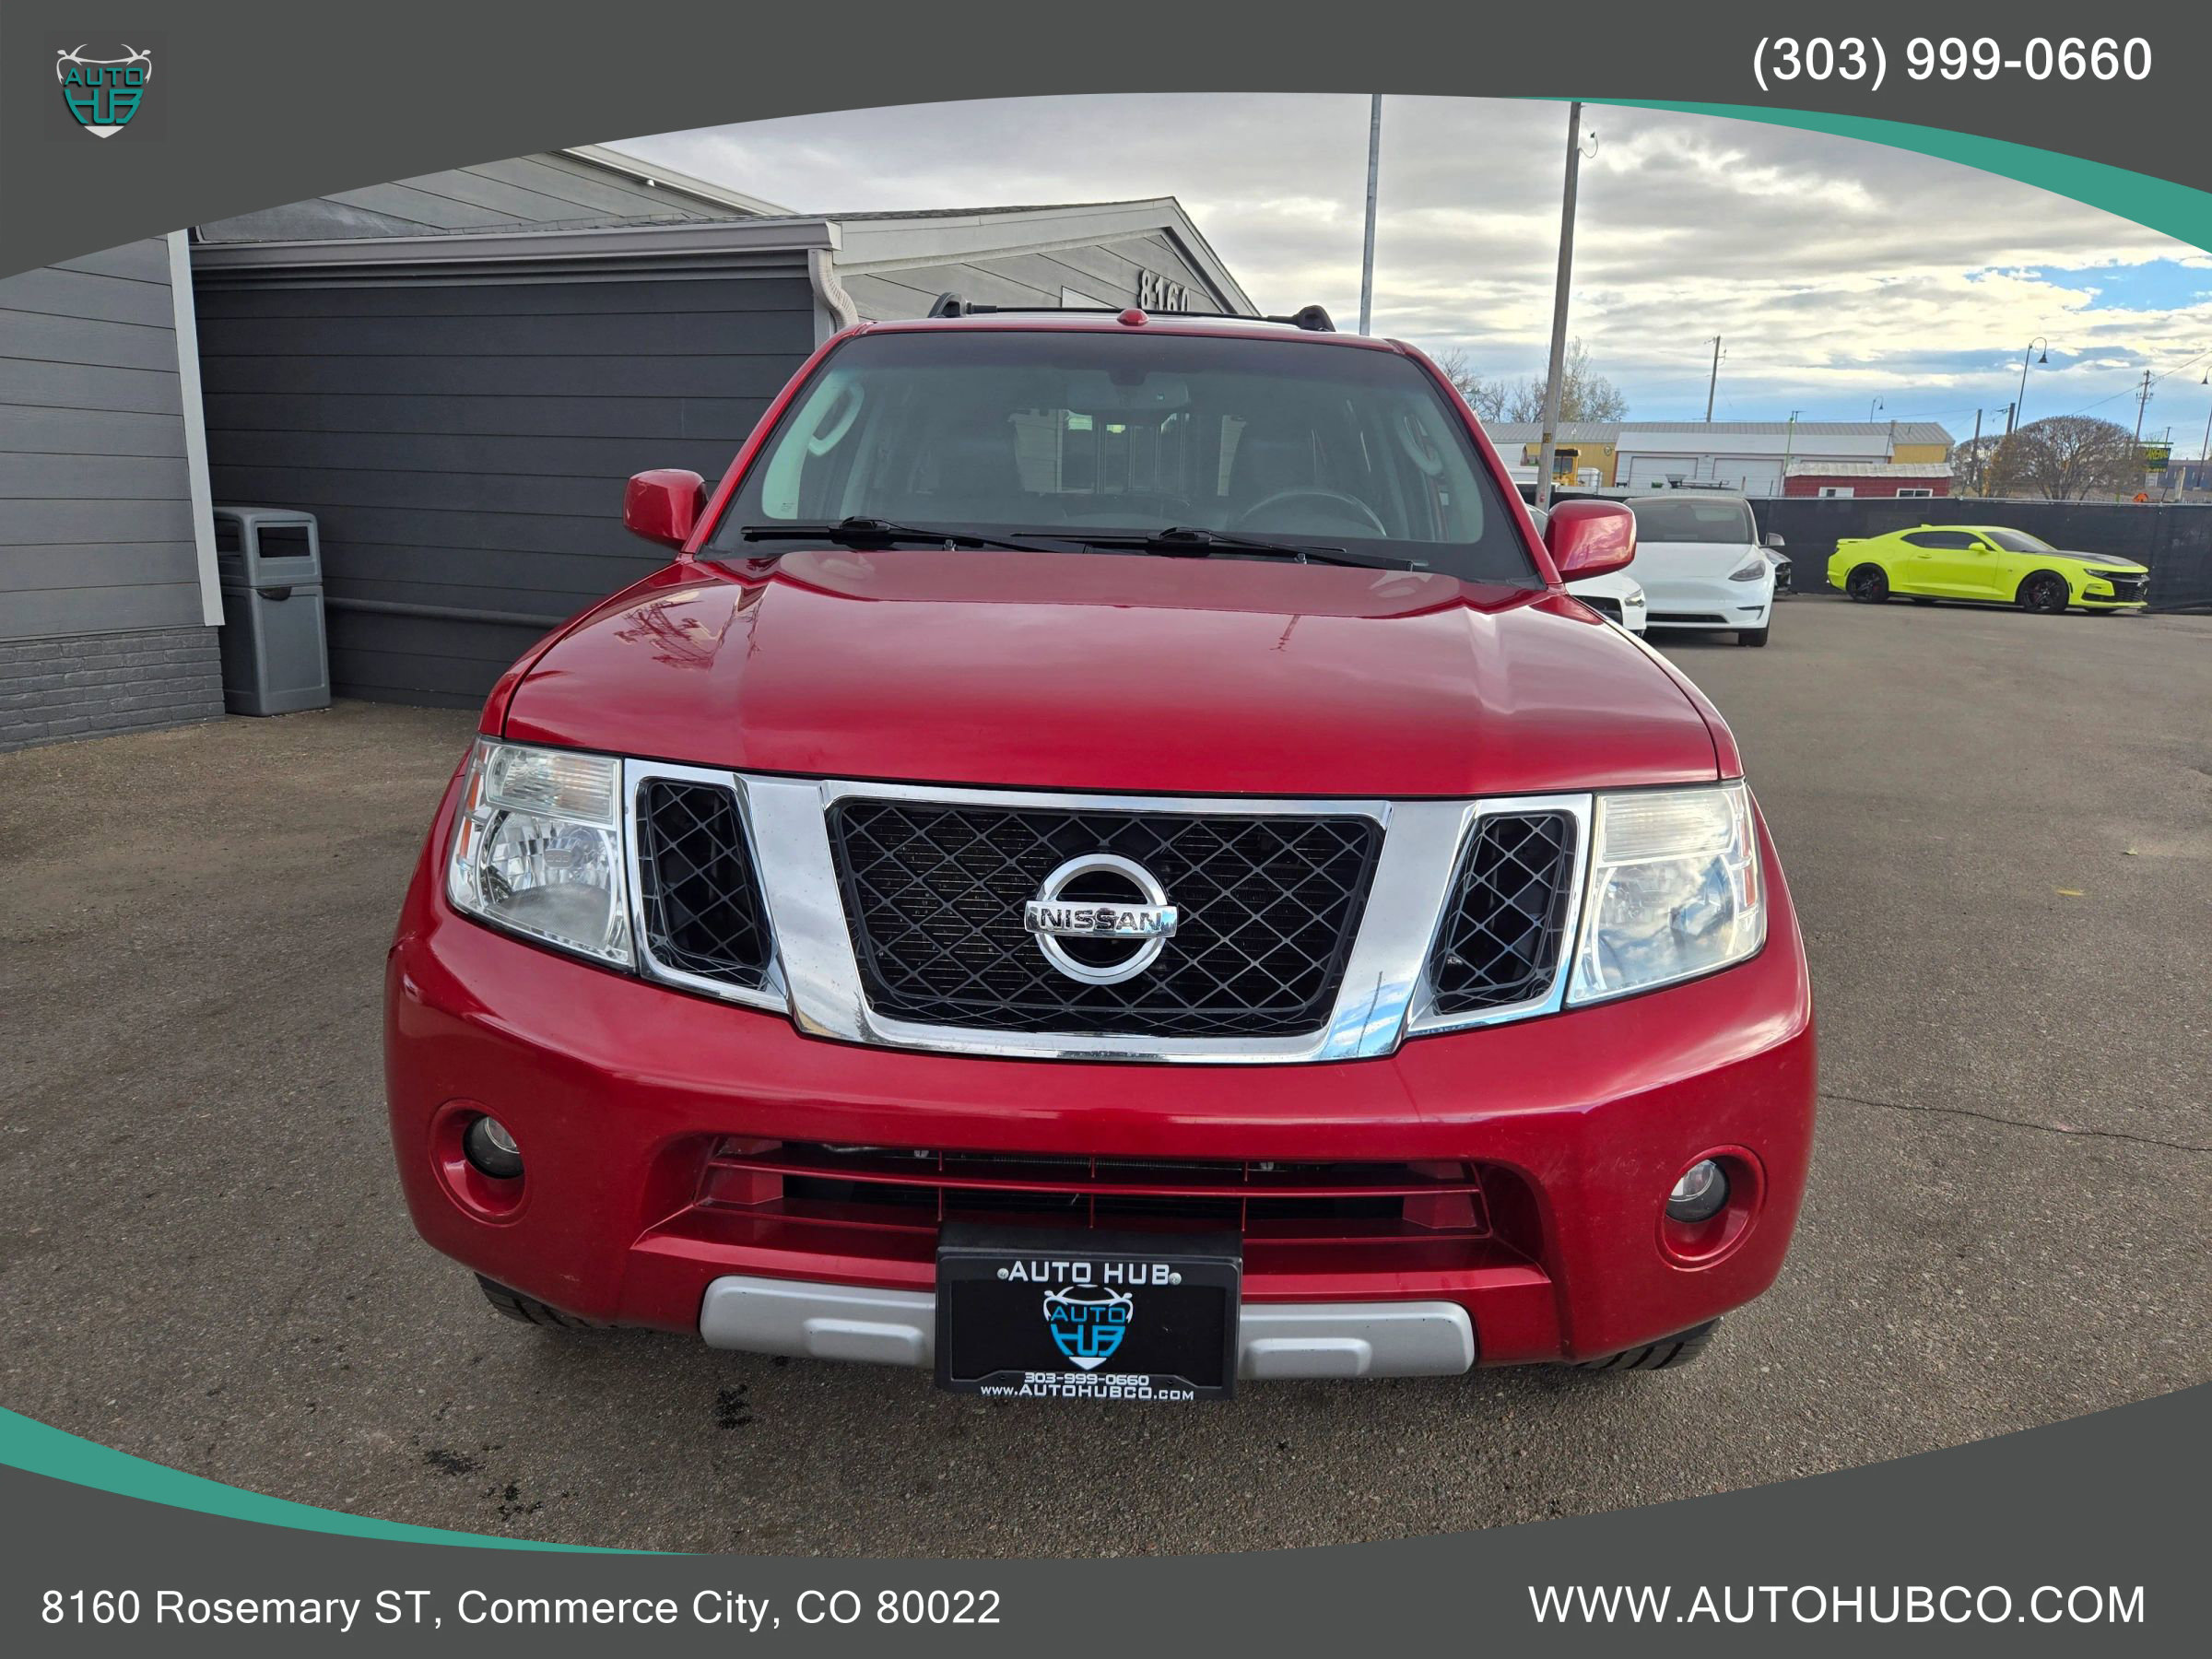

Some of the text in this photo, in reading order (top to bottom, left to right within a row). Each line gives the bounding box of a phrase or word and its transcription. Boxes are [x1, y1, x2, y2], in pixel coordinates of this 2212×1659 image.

[1040, 908, 1162, 932] NISSAN
[1008, 1261, 1170, 1286] AUTO HUB
[1051, 1306, 1126, 1324] AUTO
[1050, 1324, 1127, 1358] HUB
[1024, 1371, 1150, 1387] 303-999-0660
